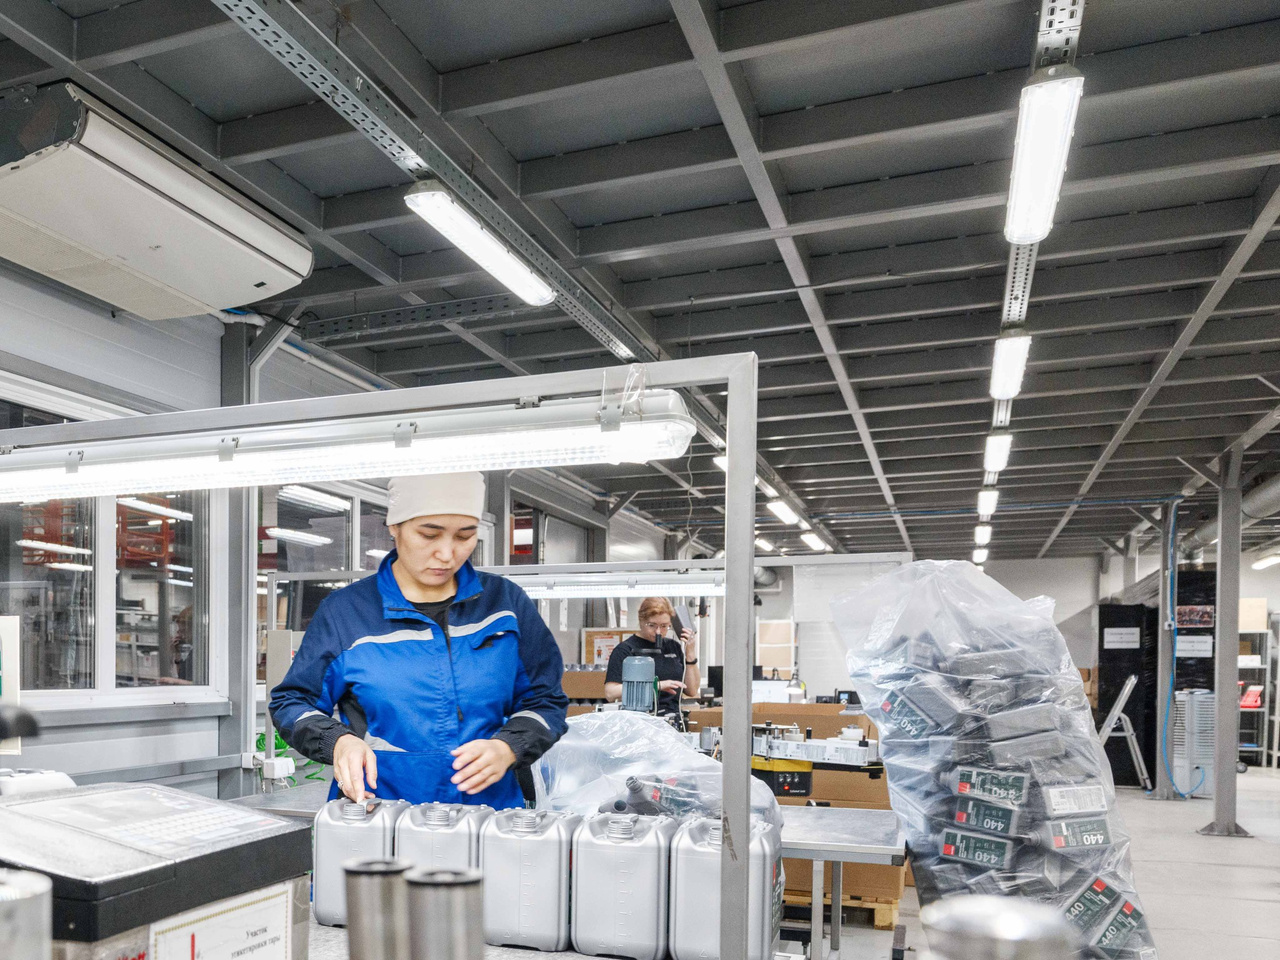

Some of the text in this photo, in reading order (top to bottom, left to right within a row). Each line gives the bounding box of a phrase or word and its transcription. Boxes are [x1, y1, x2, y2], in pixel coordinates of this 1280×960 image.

[900, 718, 918, 737] 440
[983, 818, 1005, 831] 440
[1083, 834, 1104, 845] 440
[975, 851, 999, 864] 440
[1065, 902, 1085, 922] 440
[246, 926, 268, 940] Участок
[1101, 925, 1117, 946] 440
